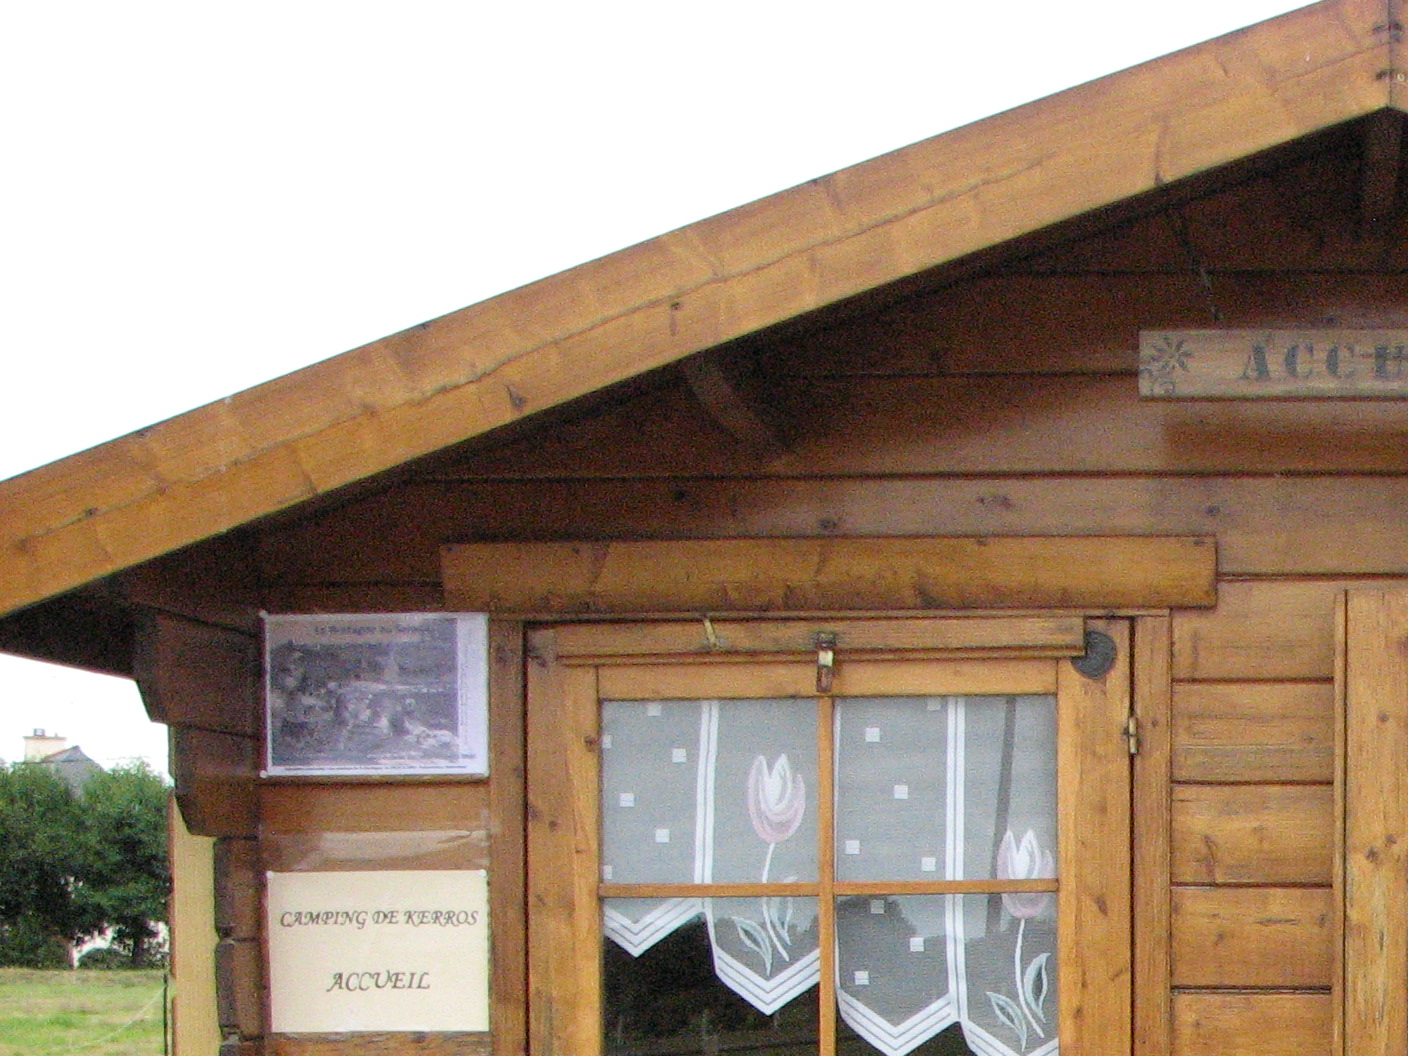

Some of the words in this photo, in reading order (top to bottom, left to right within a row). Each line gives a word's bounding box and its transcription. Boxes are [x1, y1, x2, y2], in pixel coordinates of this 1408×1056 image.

[280, 910, 368, 930] CAMPING
[372, 910, 399, 926] DE
[403, 910, 479, 928] KERROS
[326, 969, 431, 992] ACCUEIL
